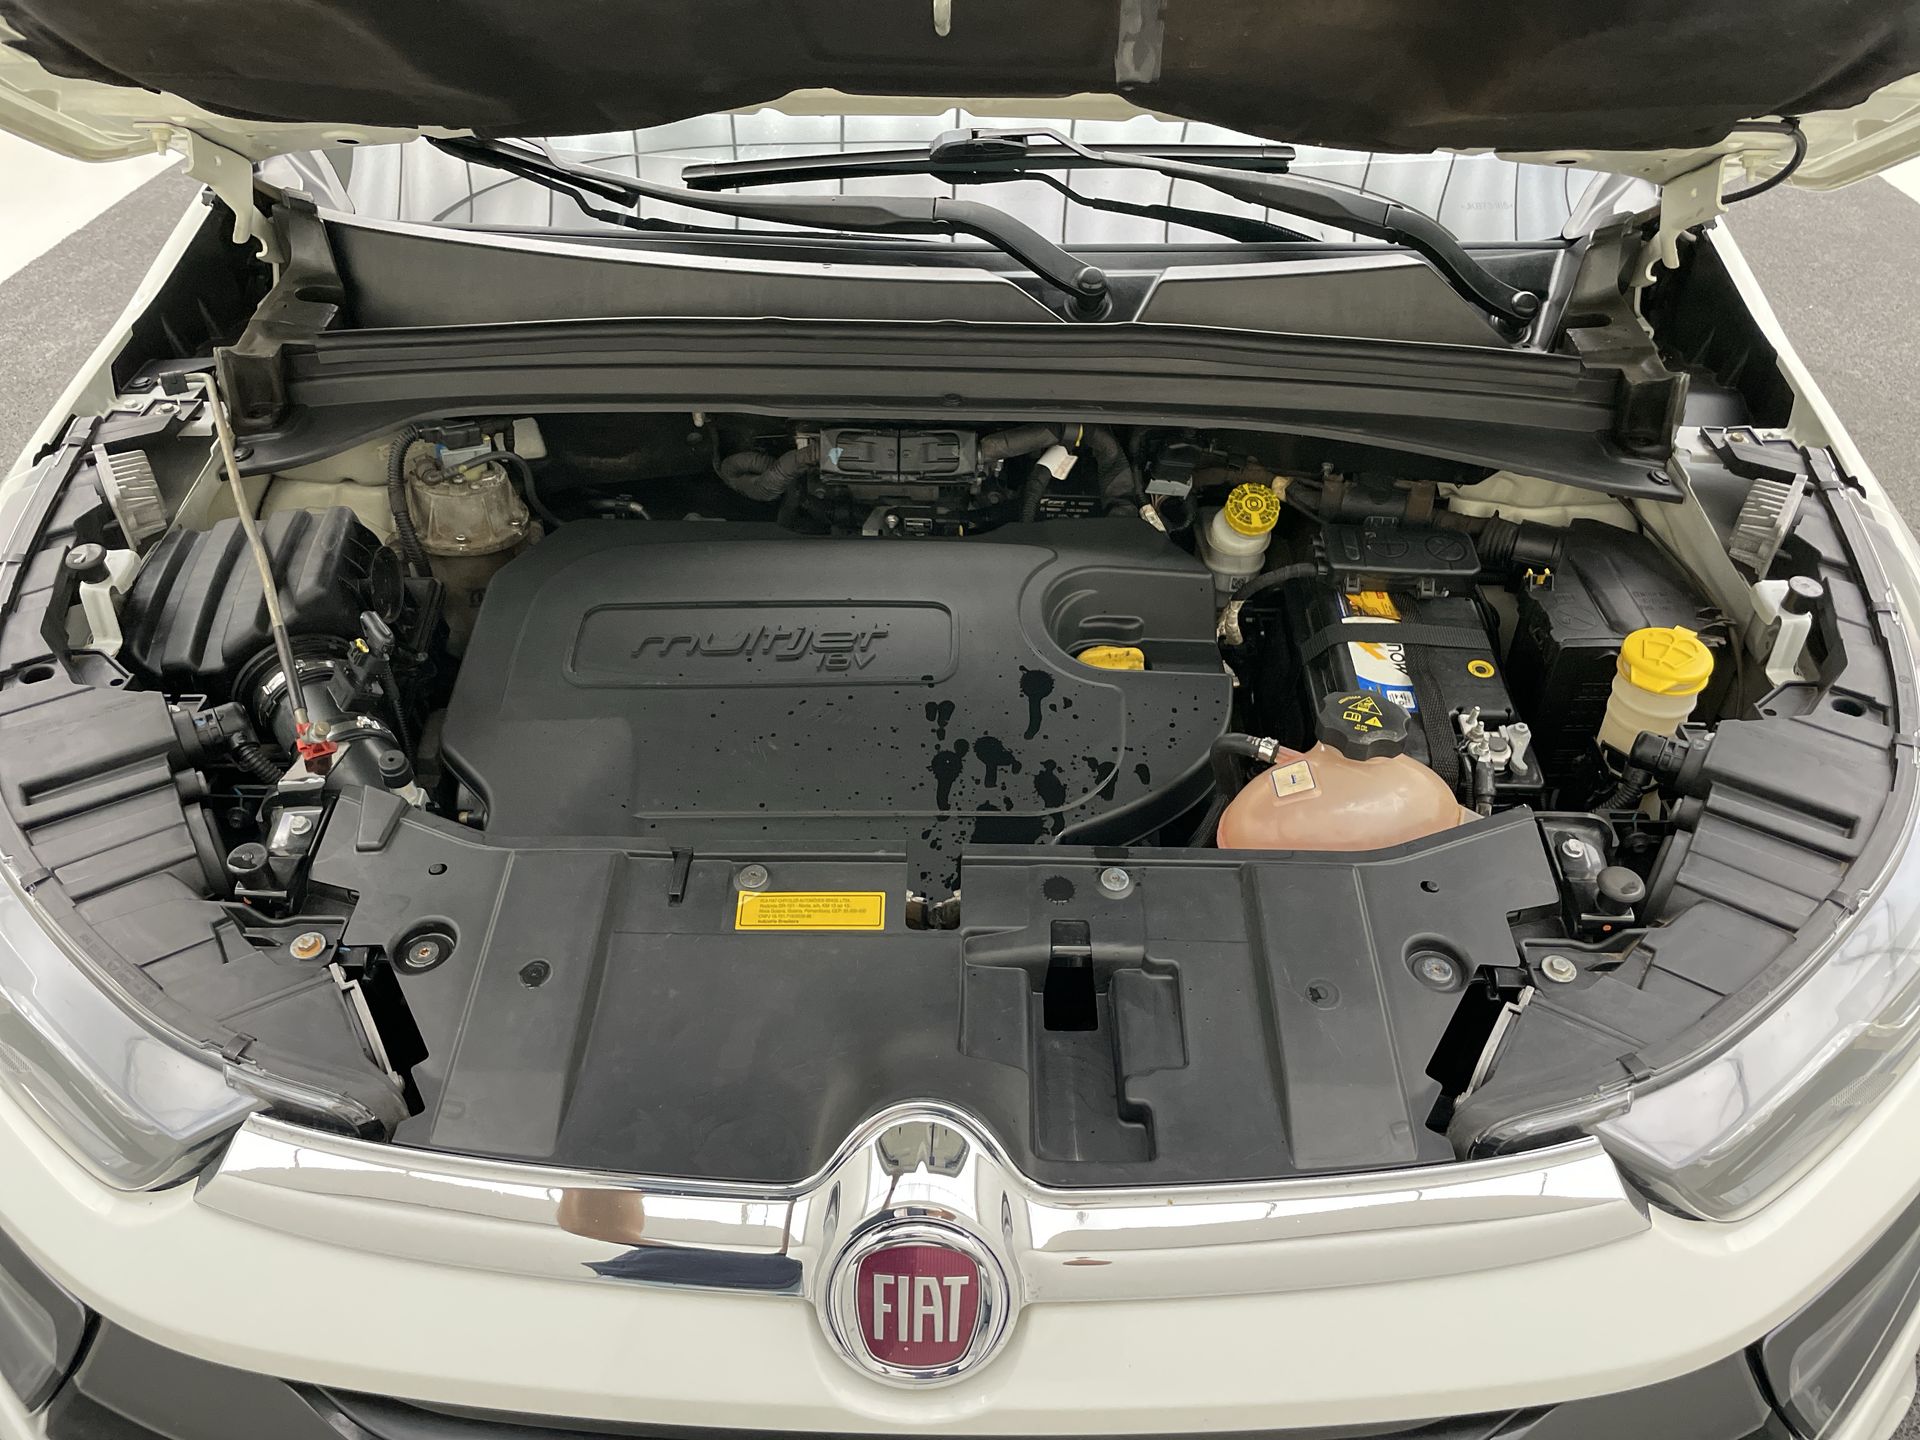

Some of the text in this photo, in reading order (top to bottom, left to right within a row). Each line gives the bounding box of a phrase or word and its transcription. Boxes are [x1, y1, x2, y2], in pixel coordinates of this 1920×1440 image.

[815, 652, 877, 673] 16V
[1386, 643, 1409, 676] MOU
[873, 1274, 969, 1343] FIAT
